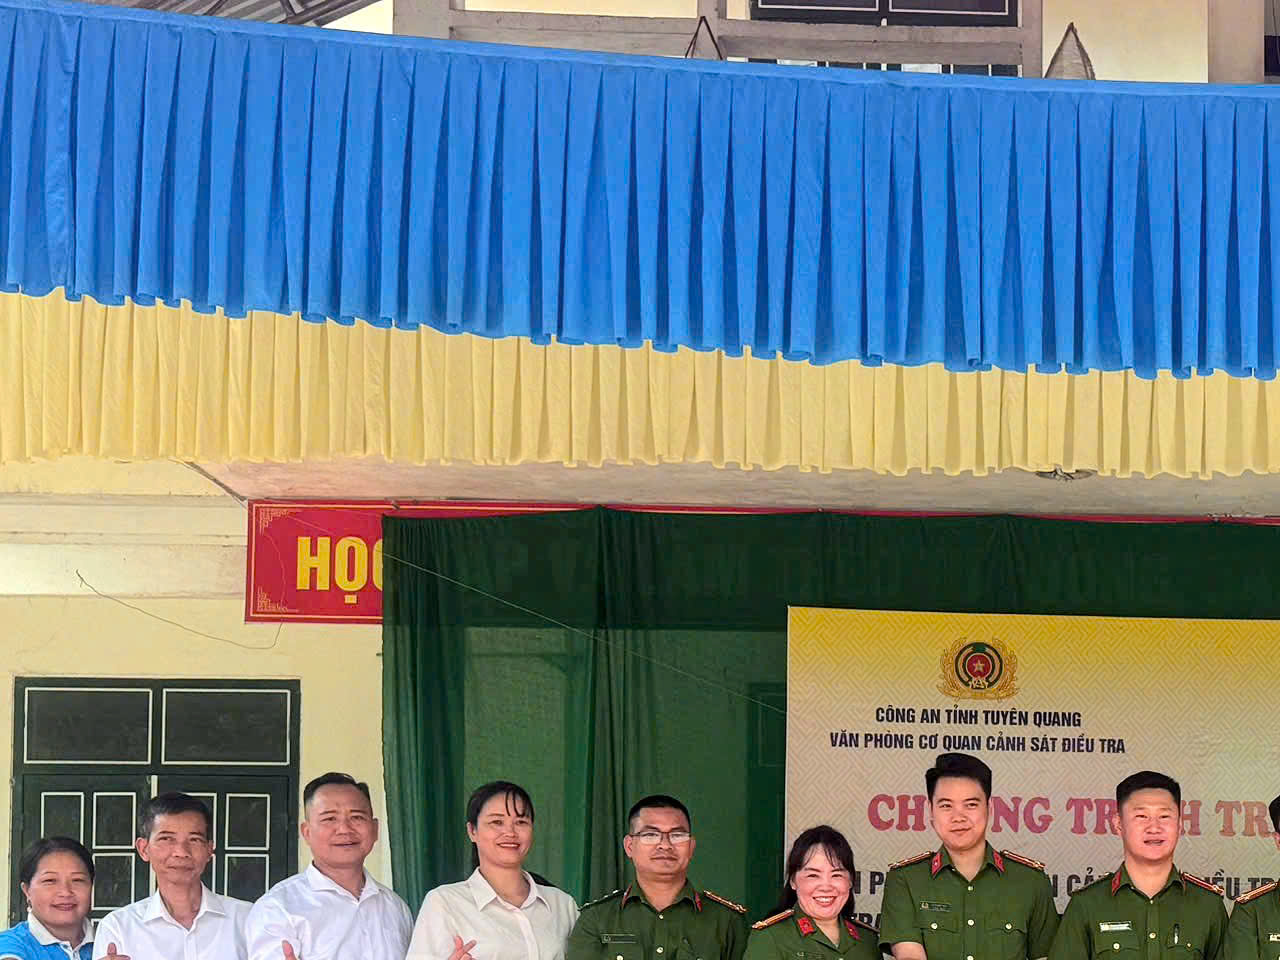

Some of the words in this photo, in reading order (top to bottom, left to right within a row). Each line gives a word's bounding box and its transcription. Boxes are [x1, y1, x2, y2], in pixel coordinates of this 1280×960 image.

[875, 705, 916, 724] CÔNG
[920, 708, 941, 724] AN
[945, 704, 979, 725] TỈNH
[983, 706, 1029, 726] TUYÊN
[1033, 711, 1081, 727] QUANG
[830, 729, 859, 748] VĂN
[864, 730, 914, 749] PHÒNG
[919, 733, 939, 749] CƠ
[943, 735, 982, 751] QUAN
[986, 732, 1026, 752] CẢNH
[1030, 733, 1058, 752] SÁT
[1062, 733, 1094, 753] ĐIỀU
[1100, 738, 1125, 753] TRA
[867, 794, 1053, 834] CHNG
[1066, 797, 1202, 836] TRH
